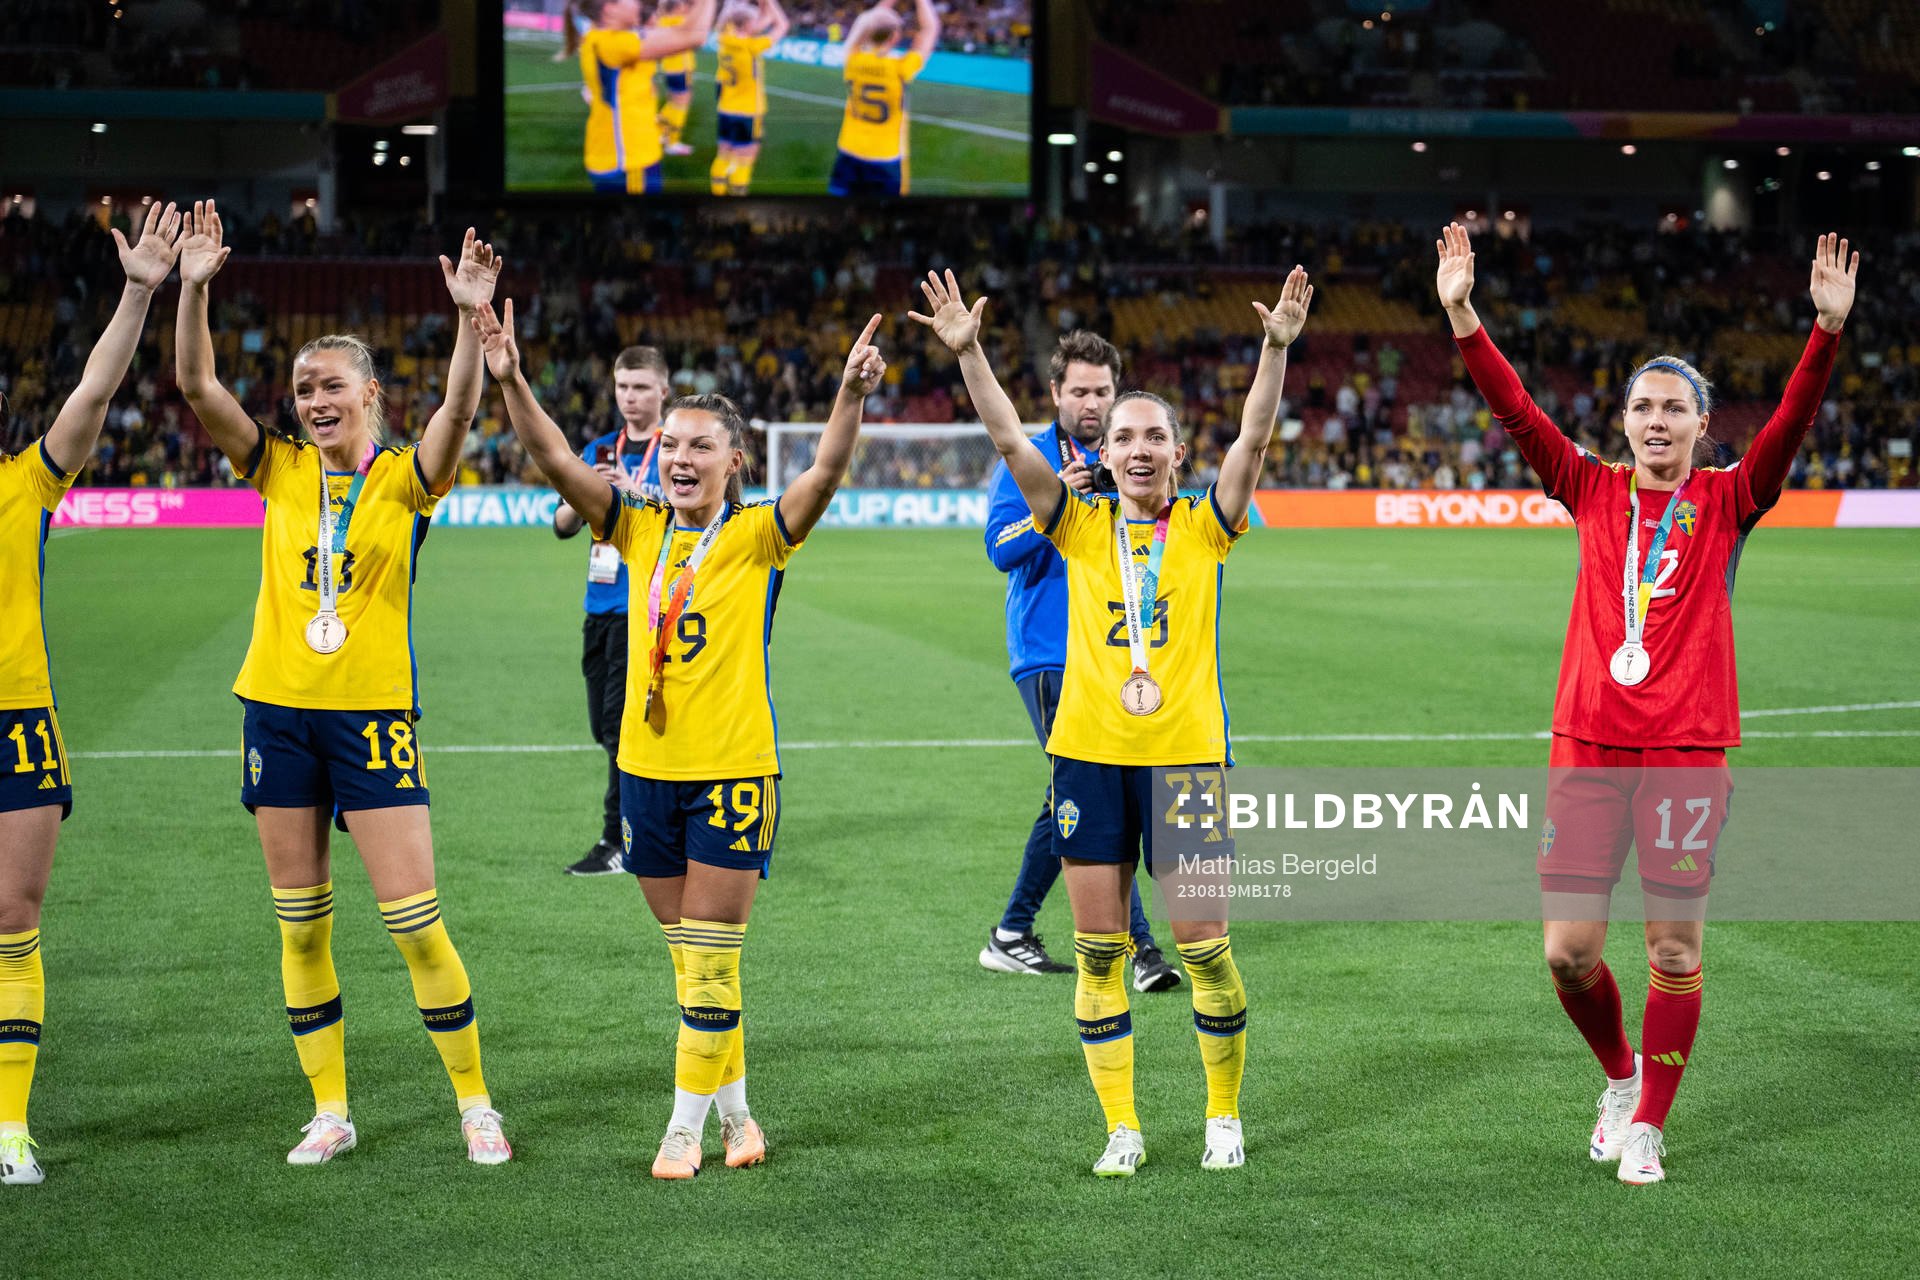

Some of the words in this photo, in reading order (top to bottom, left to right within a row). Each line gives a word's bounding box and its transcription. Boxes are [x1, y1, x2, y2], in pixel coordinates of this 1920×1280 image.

[1376, 494, 1519, 524] BEYOND
[1106, 600, 1168, 648] 23
[8, 719, 58, 773] 11
[361, 721, 418, 770] 18
[707, 782, 760, 832] 19
[1165, 771, 1223, 824] 23
[1655, 797, 1712, 850] 12
